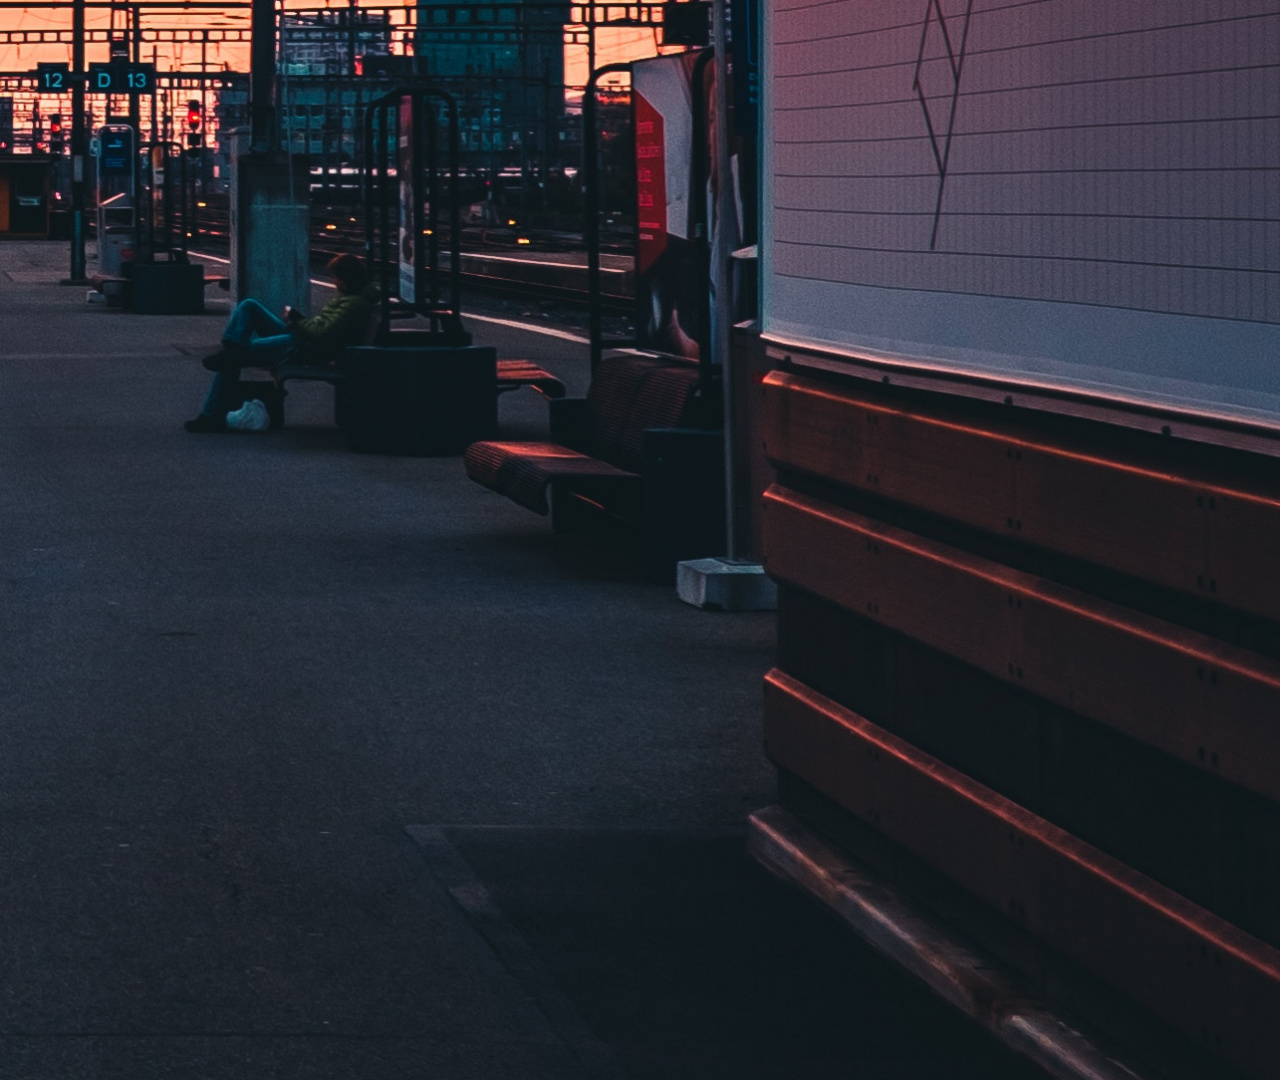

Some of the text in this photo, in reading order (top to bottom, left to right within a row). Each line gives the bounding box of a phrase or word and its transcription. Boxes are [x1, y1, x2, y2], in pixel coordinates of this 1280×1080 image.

[44, 72, 63, 88] 12
[97, 72, 112, 88] D
[127, 72, 147, 88] 13
